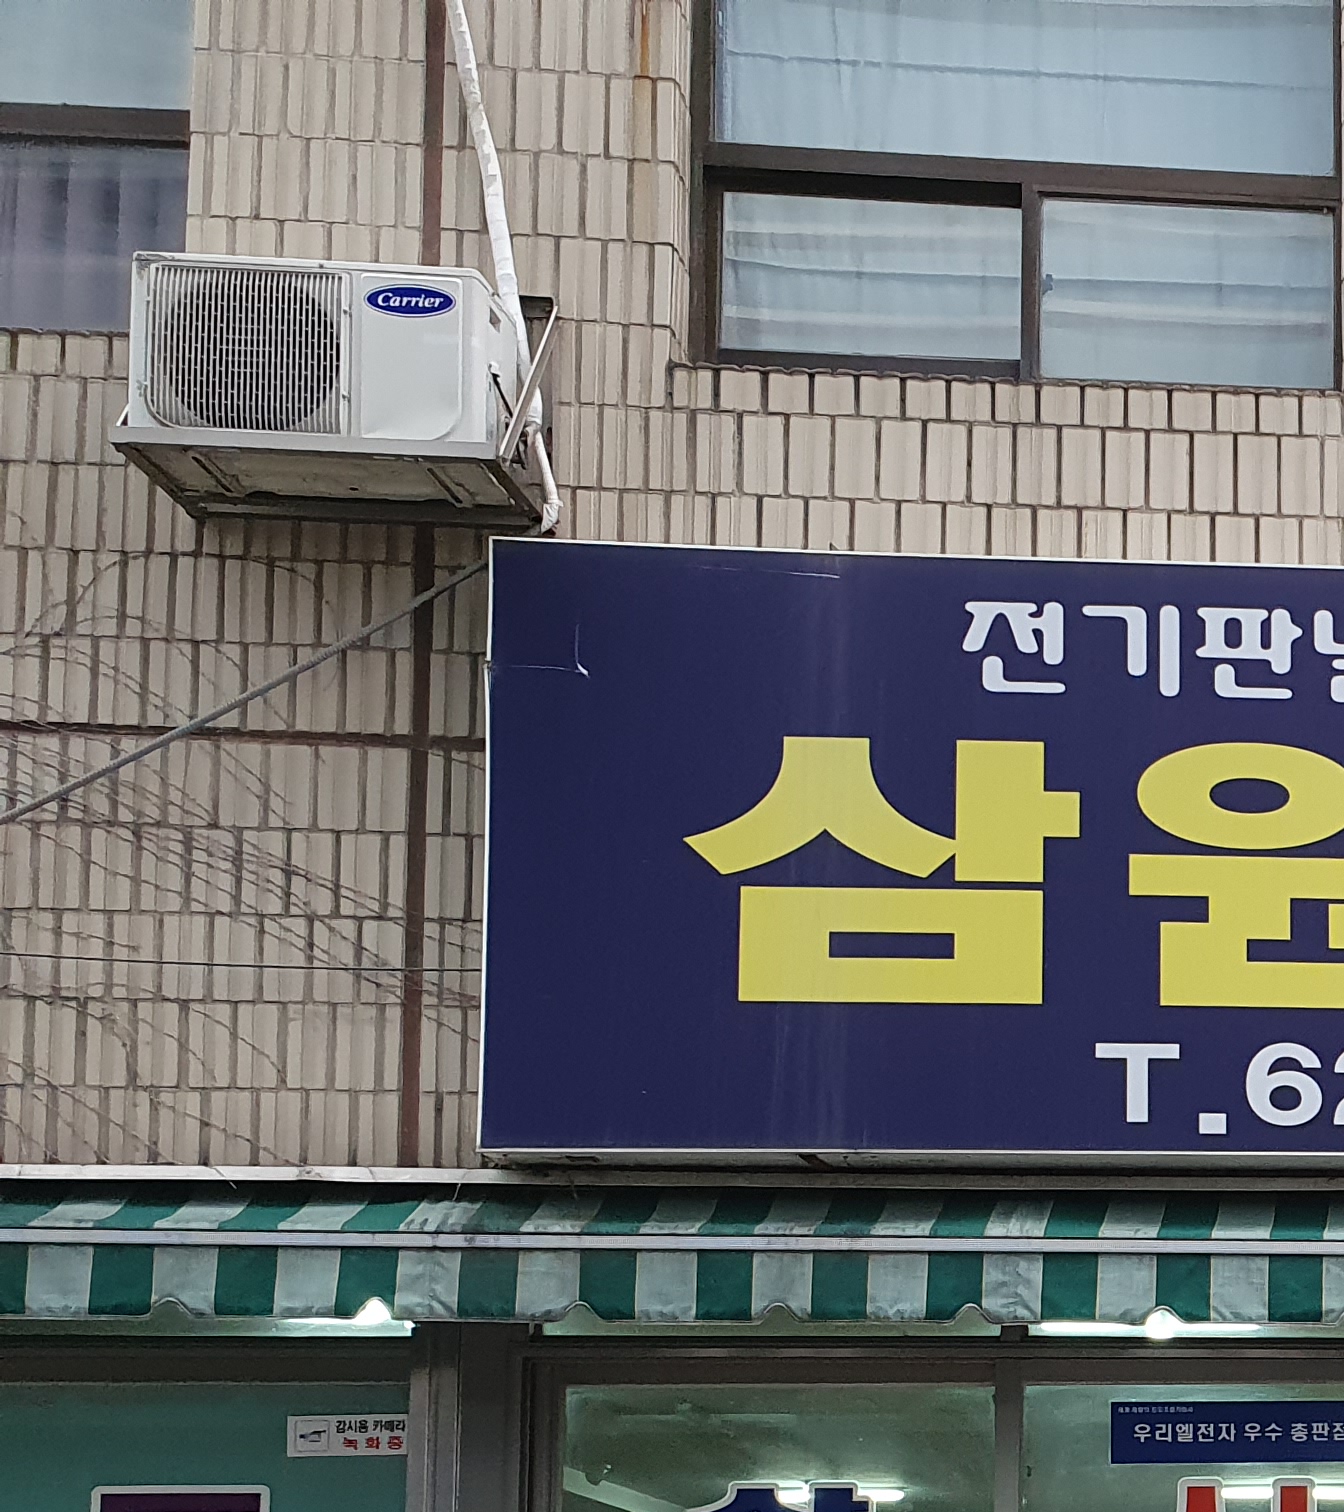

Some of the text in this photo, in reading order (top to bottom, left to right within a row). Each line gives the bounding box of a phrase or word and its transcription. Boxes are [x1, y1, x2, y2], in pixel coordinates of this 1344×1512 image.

[377, 292, 444, 308] Carrier
[372, 1420, 406, 1432] 카메라
[1133, 1422, 1236, 1443] 우리엘전자
[1243, 1422, 1284, 1442] 우수
